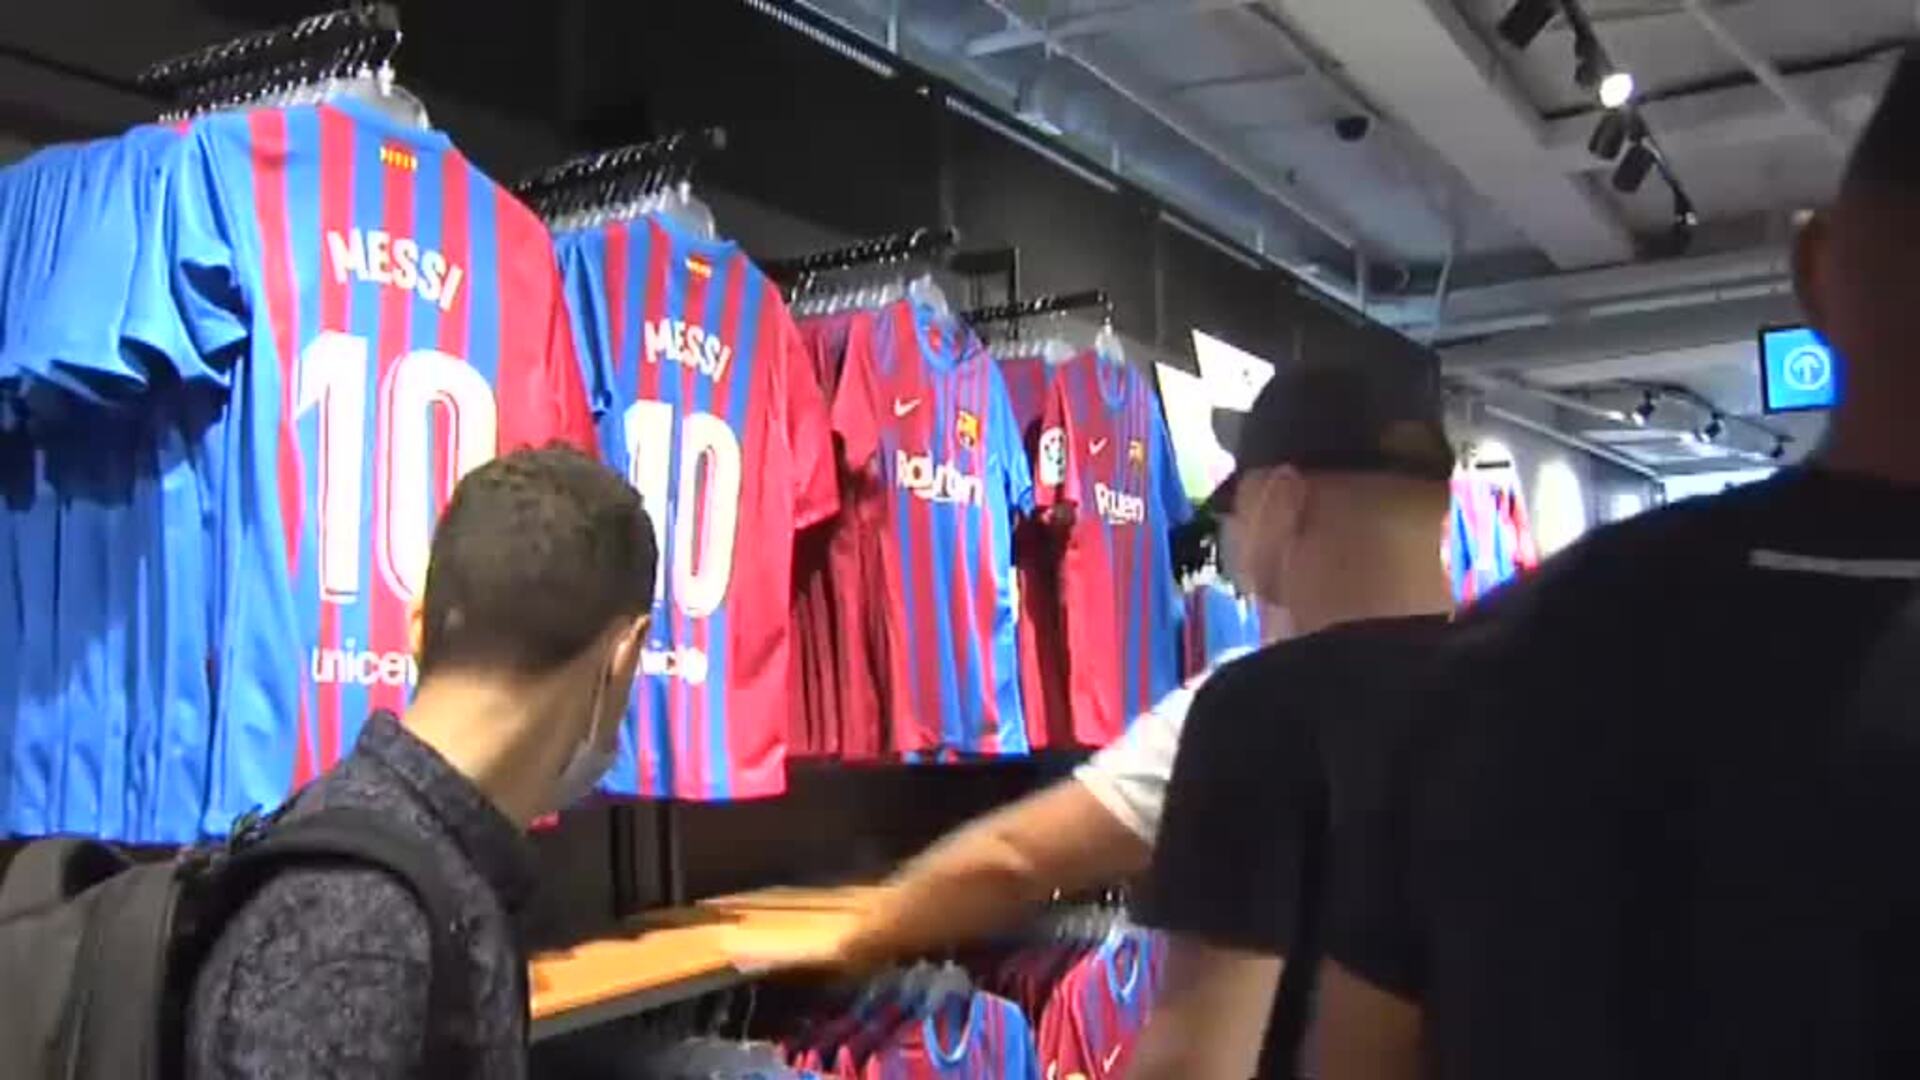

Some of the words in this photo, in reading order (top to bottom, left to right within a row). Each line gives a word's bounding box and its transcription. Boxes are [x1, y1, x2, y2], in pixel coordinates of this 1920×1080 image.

[327, 228, 464, 311] MESSI
[644, 318, 732, 383] MESSI
[291, 329, 498, 603] 10
[624, 399, 742, 618] 10
